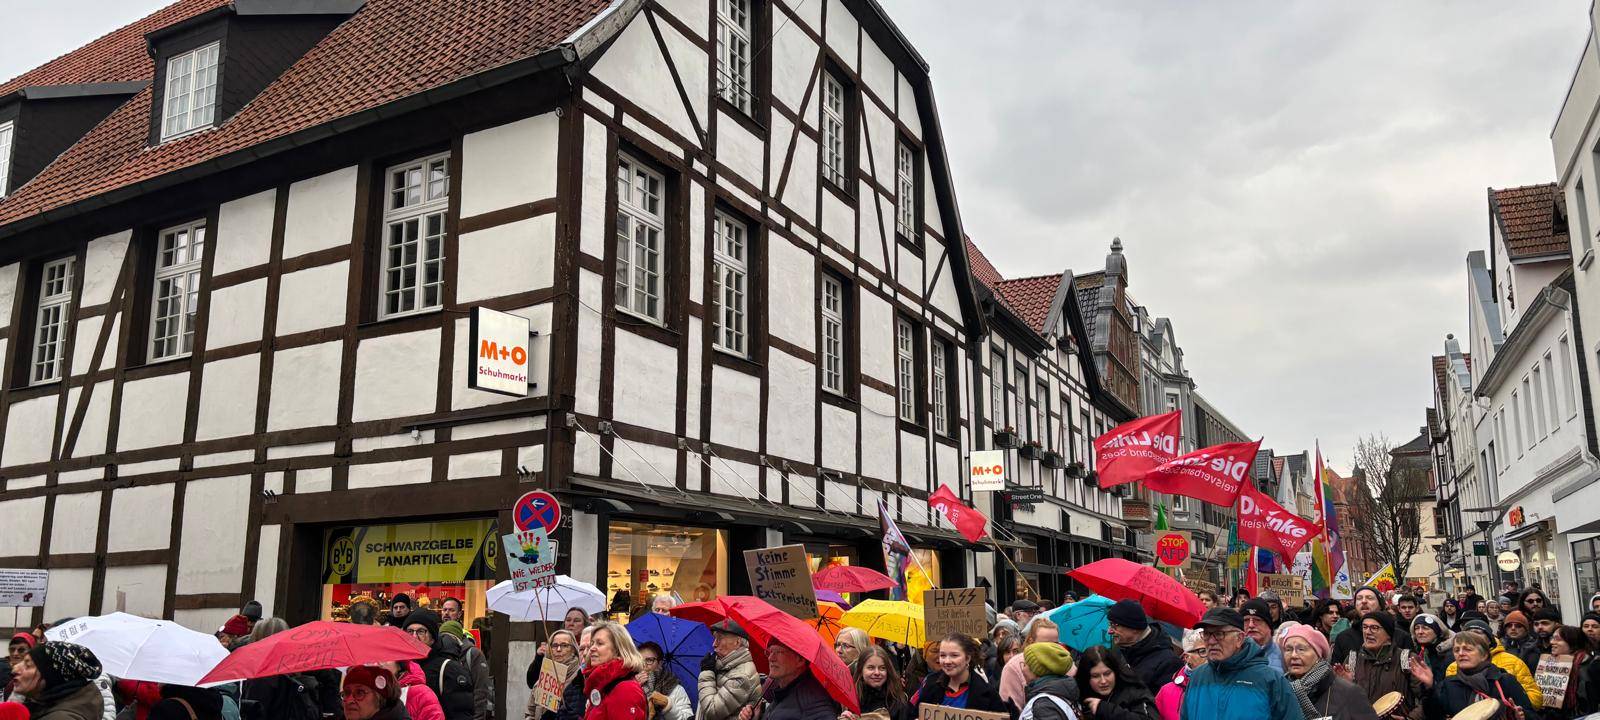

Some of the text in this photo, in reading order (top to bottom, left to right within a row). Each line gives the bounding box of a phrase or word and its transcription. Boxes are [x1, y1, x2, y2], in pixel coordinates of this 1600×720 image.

[480, 339, 527, 366] M+O
[479, 366, 527, 383] Schuhmarkt
[972, 464, 1003, 476] M+O
[562, 514, 573, 529] 25
[366, 538, 474, 554] SCHWARZGELBE
[1162, 538, 1185, 548] STOP
[378, 553, 458, 568] FANARTIKEL
[757, 552, 788, 566] Keine
[338, 564, 346, 572] 09
[756, 566, 796, 581] Stimme
[756, 585, 816, 608] Extremisten
[934, 589, 977, 607] HASS
